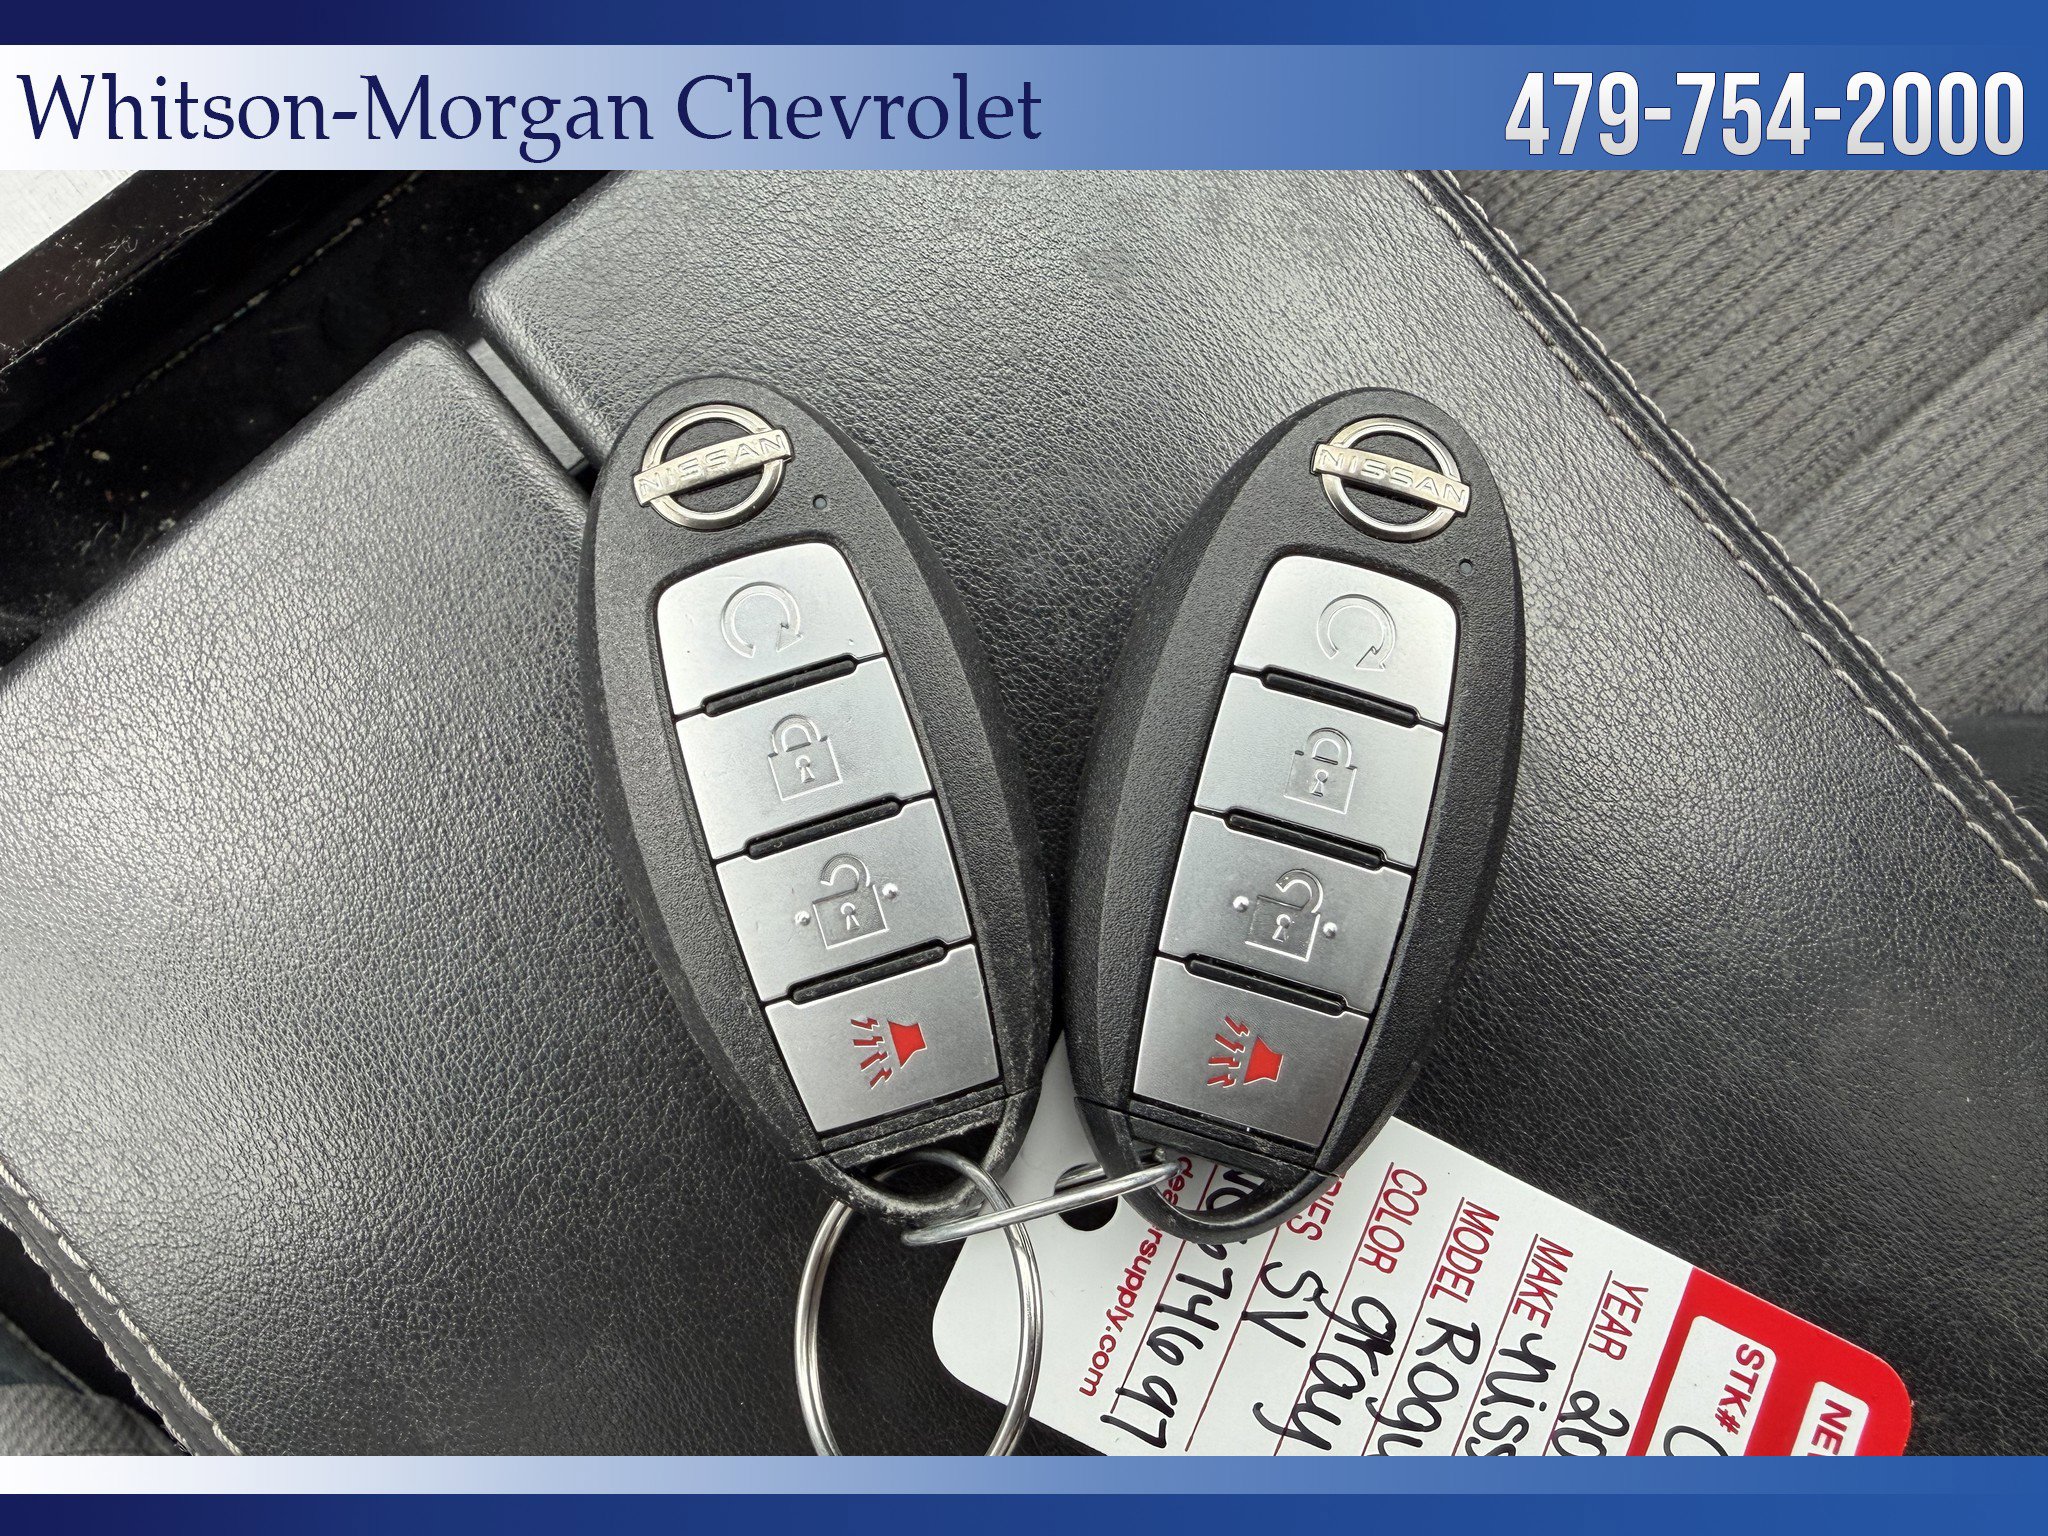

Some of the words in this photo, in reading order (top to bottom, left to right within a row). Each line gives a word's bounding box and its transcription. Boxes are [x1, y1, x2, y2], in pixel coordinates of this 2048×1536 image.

[638, 433, 787, 496] NISSAN
[1318, 449, 1467, 506] NISSAN
[1286, 1173, 1346, 1241] RIES
[1358, 1168, 1428, 1274] COLOR
[1429, 1200, 1500, 1303] MODEL
[1079, 1156, 1194, 1397] dearsupply.com
[1240, 1262, 1328, 1348] SV
[1512, 1236, 1574, 1328] MAKE
[1588, 1278, 1649, 1362] YEAR
[1253, 1295, 1397, 1451] gray
[1715, 1343, 1766, 1436] STK#
[1806, 1398, 1853, 1456] NE
